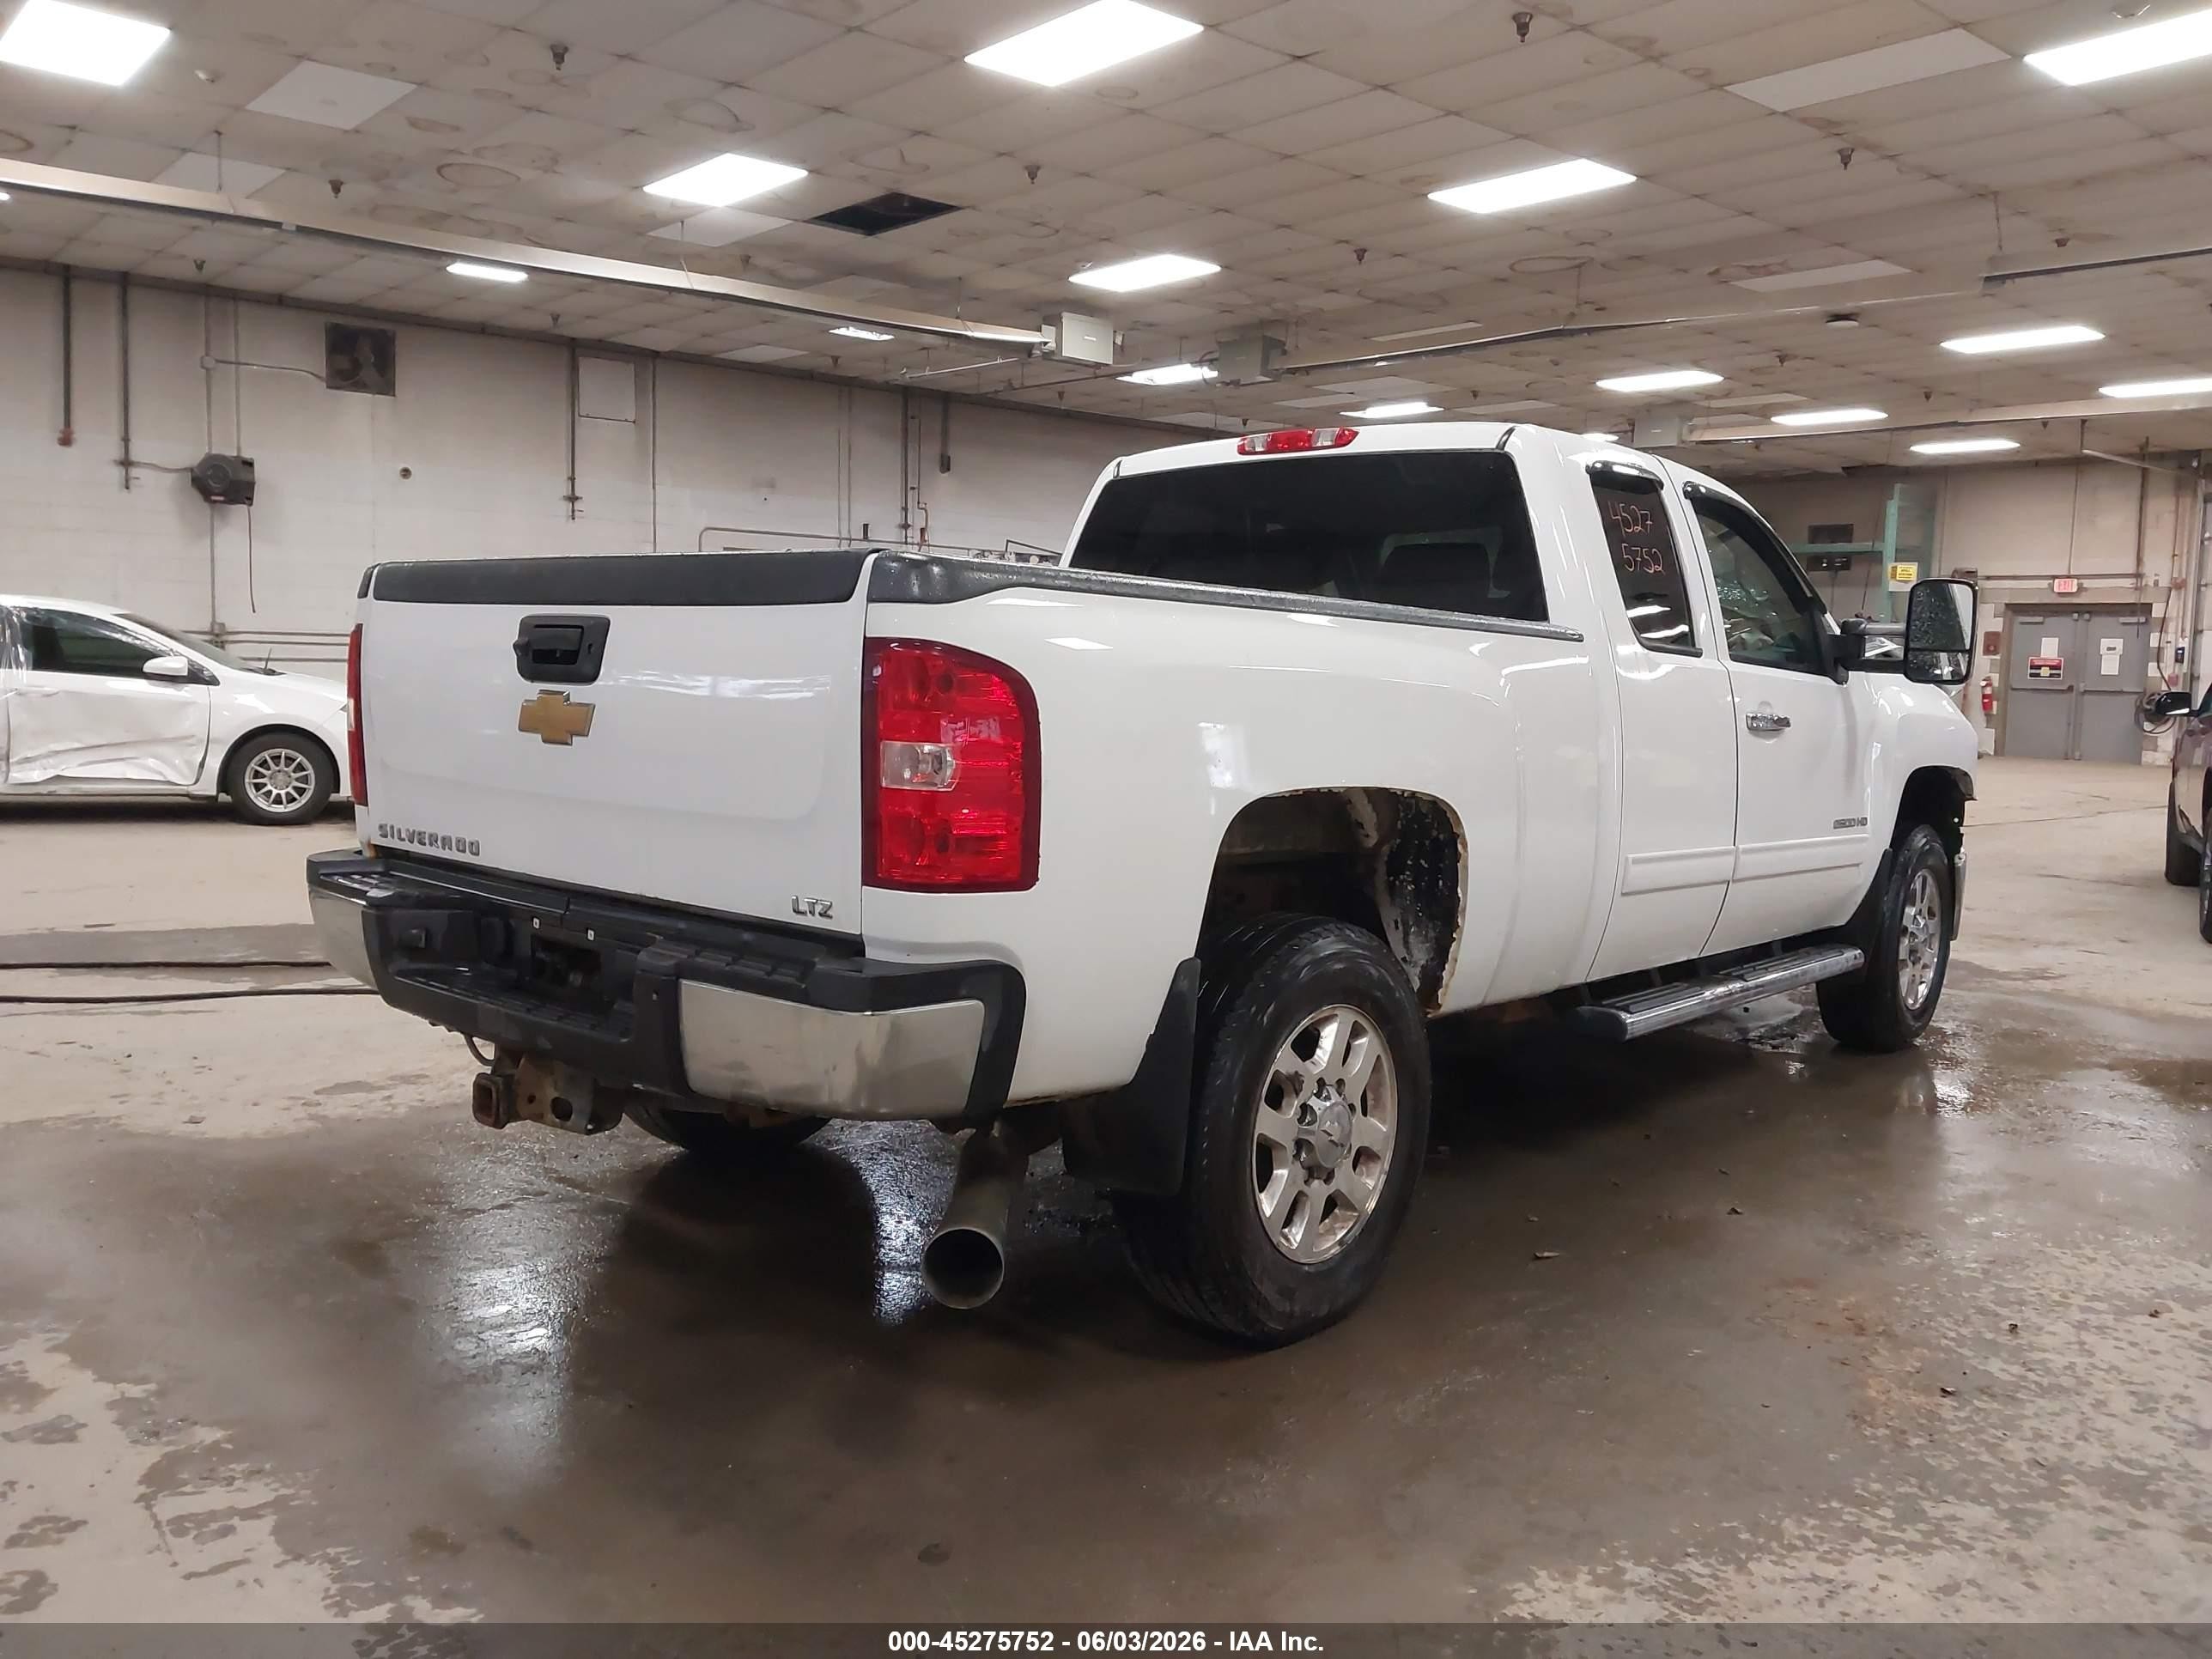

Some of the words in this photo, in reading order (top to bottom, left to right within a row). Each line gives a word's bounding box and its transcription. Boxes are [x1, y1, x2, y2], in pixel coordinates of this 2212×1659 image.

[1607, 500, 1653, 538] 4527
[1621, 543, 1666, 575] 5752
[2057, 580, 2075, 591] EXIT
[378, 823, 481, 857] SILVERADO
[791, 896, 833, 920] LTZ
